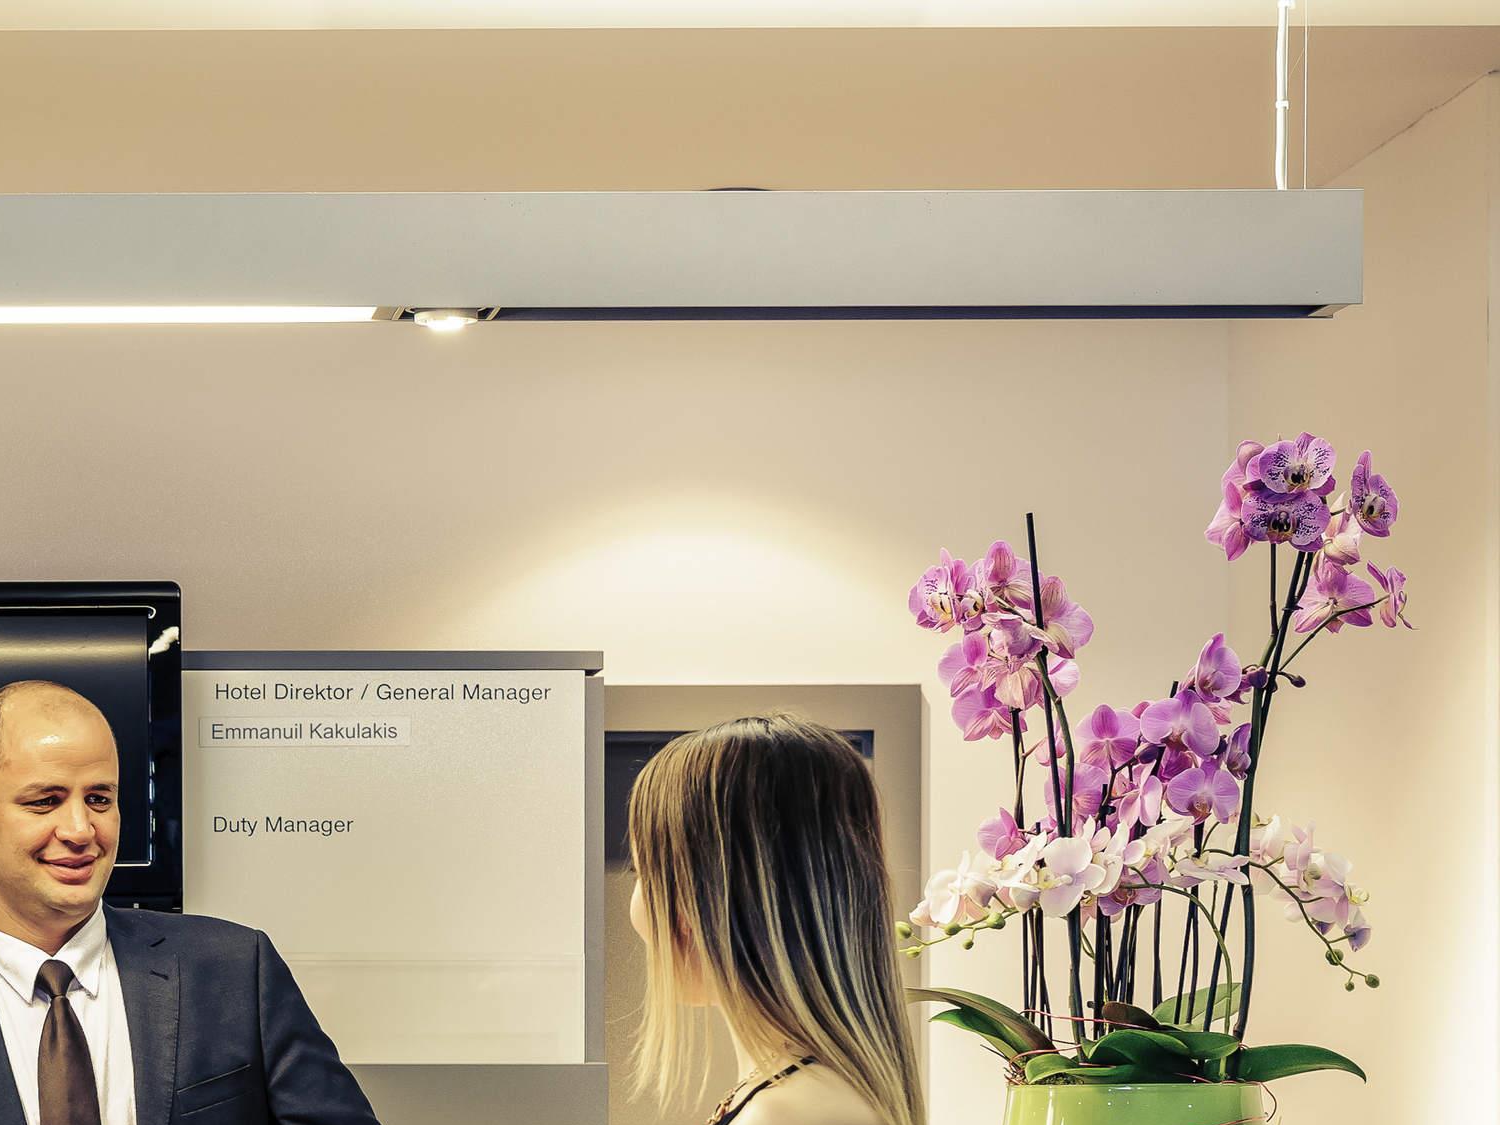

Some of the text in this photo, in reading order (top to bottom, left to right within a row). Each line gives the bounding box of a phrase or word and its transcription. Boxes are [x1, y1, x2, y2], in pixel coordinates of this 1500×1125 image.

[215, 683, 552, 704] Hotel Direktor / General Manager
[211, 722, 398, 740] Emmanuil Kakulakis
[213, 816, 355, 837] Duty Manager
